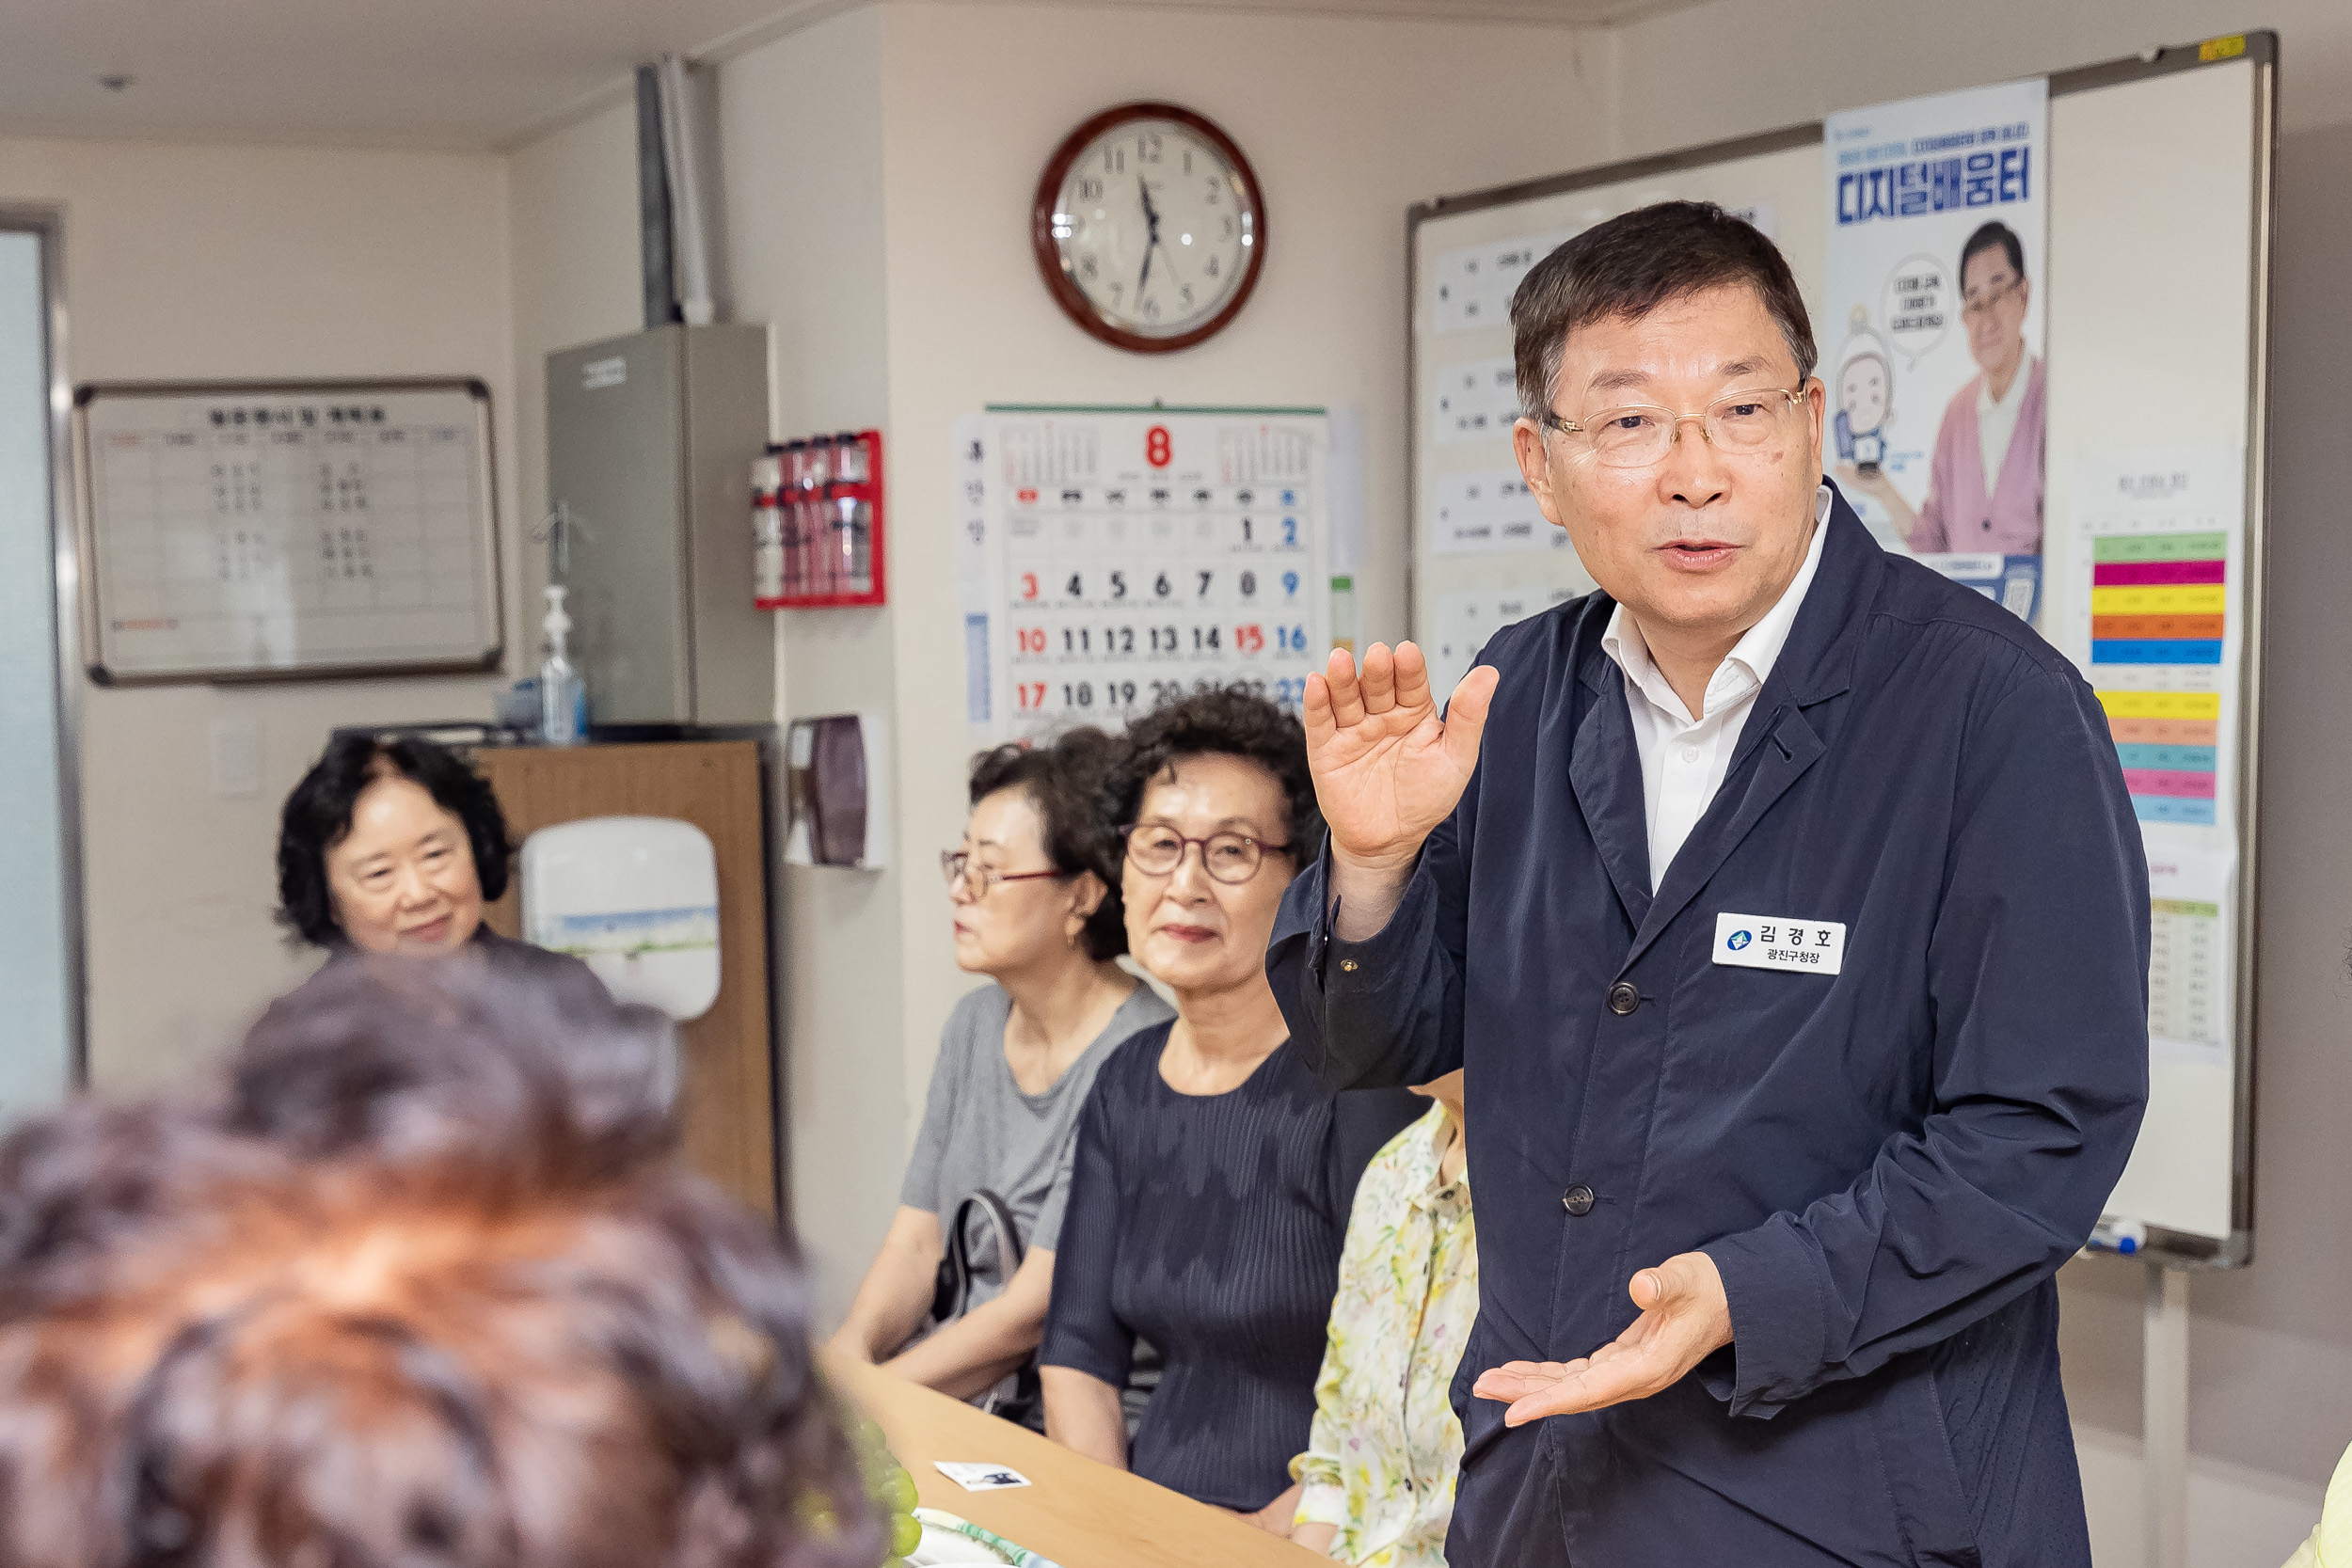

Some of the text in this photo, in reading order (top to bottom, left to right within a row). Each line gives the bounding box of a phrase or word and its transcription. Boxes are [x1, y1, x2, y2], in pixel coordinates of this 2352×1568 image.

[1104, 144, 1124, 174] 11
[1137, 135, 1163, 164] 12
[1183, 150, 1192, 175] 1
[1081, 179, 1103, 201] 10
[1205, 176, 1220, 205] 2
[1836, 146, 2030, 225] 디지털배움터
[1204, 254, 1219, 278] 4
[1110, 281, 1124, 308] 7
[1180, 283, 1195, 311] 5
[1145, 425, 1173, 468] 8
[1242, 516, 1297, 546] 1 2
[1021, 572, 1040, 601] 3
[1065, 571, 1083, 597] 4
[1108, 570, 1127, 599] 5
[1153, 569, 1171, 597] 6
[1197, 569, 1214, 597] 7
[1281, 570, 1299, 597] 9
[1017, 623, 1308, 654] 10 11 12 13 14 15 16
[1017, 681, 1048, 708] 17
[1106, 679, 1136, 706] 19
[1768, 949, 1820, 964] 광진구청장
